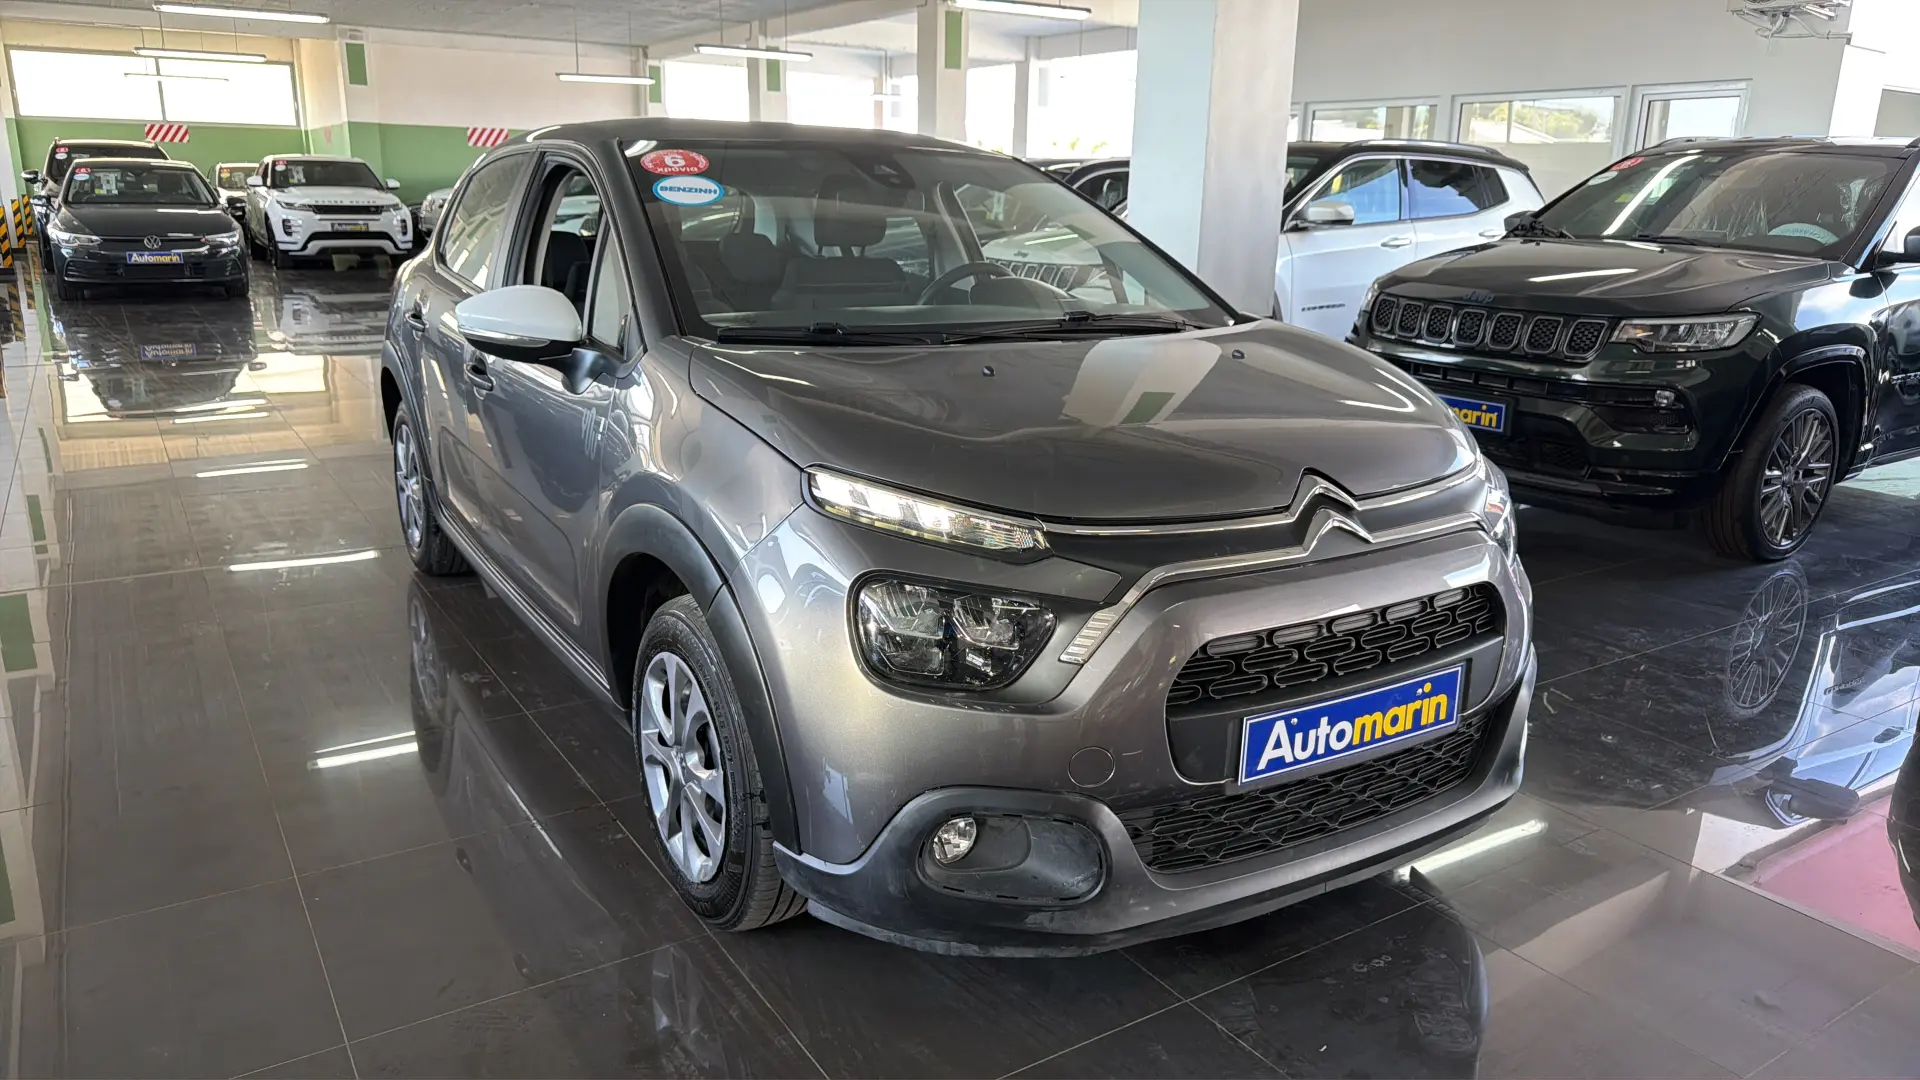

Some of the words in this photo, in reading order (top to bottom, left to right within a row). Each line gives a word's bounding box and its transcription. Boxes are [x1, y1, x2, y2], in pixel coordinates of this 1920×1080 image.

[664, 154, 686, 167] 6
[130, 252, 181, 263] Automarin
[1256, 682, 1448, 771] Automarin
